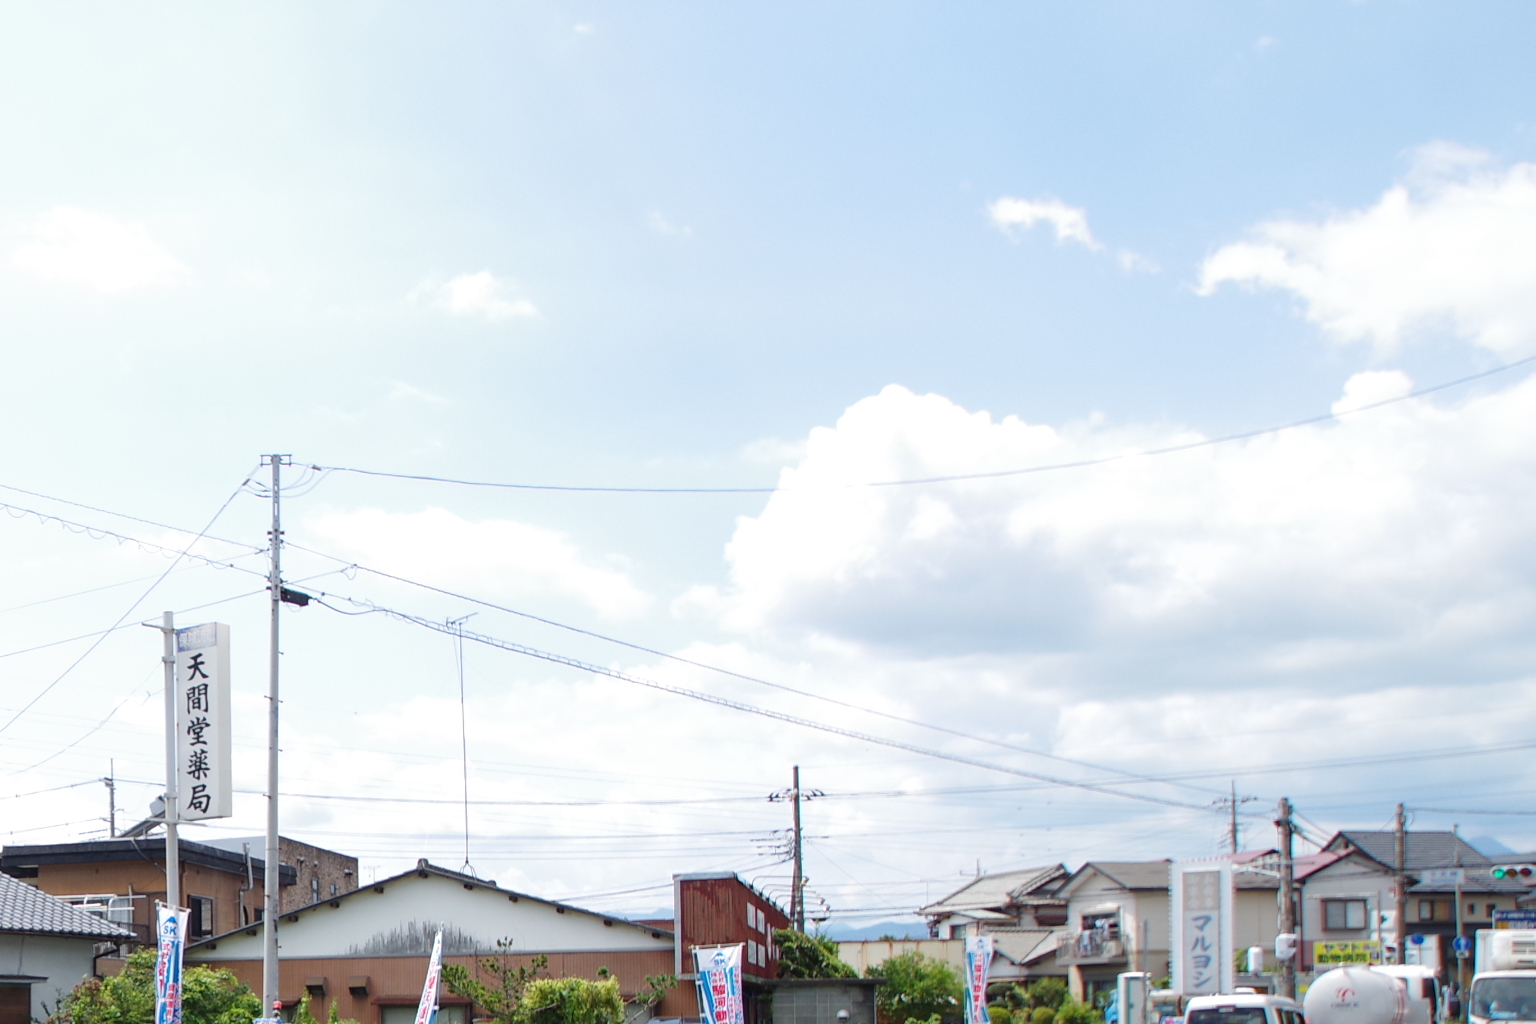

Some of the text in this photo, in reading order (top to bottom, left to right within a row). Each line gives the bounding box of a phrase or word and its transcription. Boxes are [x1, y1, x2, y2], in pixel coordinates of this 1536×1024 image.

[186, 653, 211, 814] 天間堂薬局
[163, 925, 177, 936] SK
[1190, 914, 1212, 988] マルヨシ
